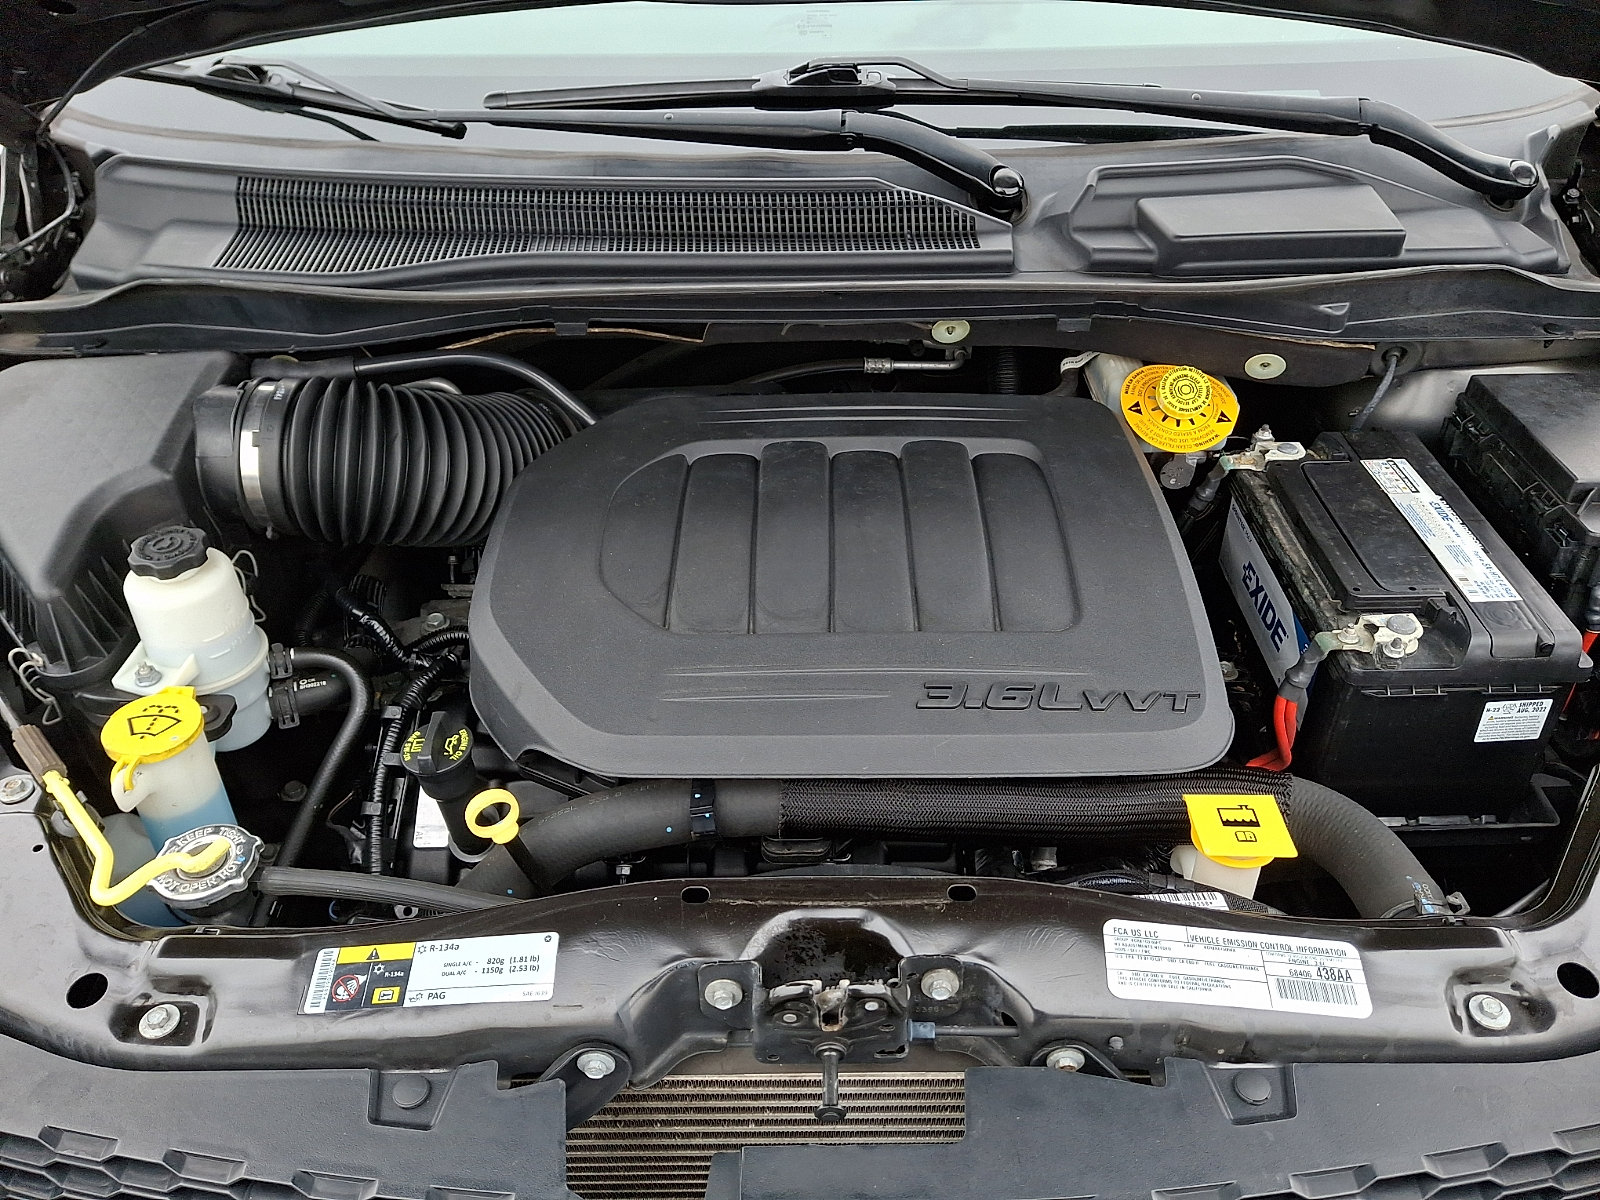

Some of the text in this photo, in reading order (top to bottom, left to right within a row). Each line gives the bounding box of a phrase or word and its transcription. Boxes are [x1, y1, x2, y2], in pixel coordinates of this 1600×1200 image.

[1242, 561, 1289, 653] EXIDE
[449, 728, 470, 761] ENGINE OIL
[176, 827, 247, 848] KEEP TIGHT
[180, 879, 219, 893] OPEN
[1113, 927, 1159, 939] FCA US LLC
[429, 942, 461, 953] R-134a
[1189, 933, 1220, 945] VEHICLE
[1222, 937, 1258, 949] EMISSION
[1260, 941, 1294, 952] CONTROL
[1296, 945, 1348, 957] INFORMATION
[486, 957, 505, 966] 820g
[509, 956, 528, 965] (1.81
[530, 954, 540, 964] lb)
[481, 966, 504, 975] 1150g
[509, 965, 528, 974] (2.53
[530, 963, 540, 973] lb)
[1288, 967, 1353, 982] 68406 438AA
[427, 991, 446, 1000] PAG
